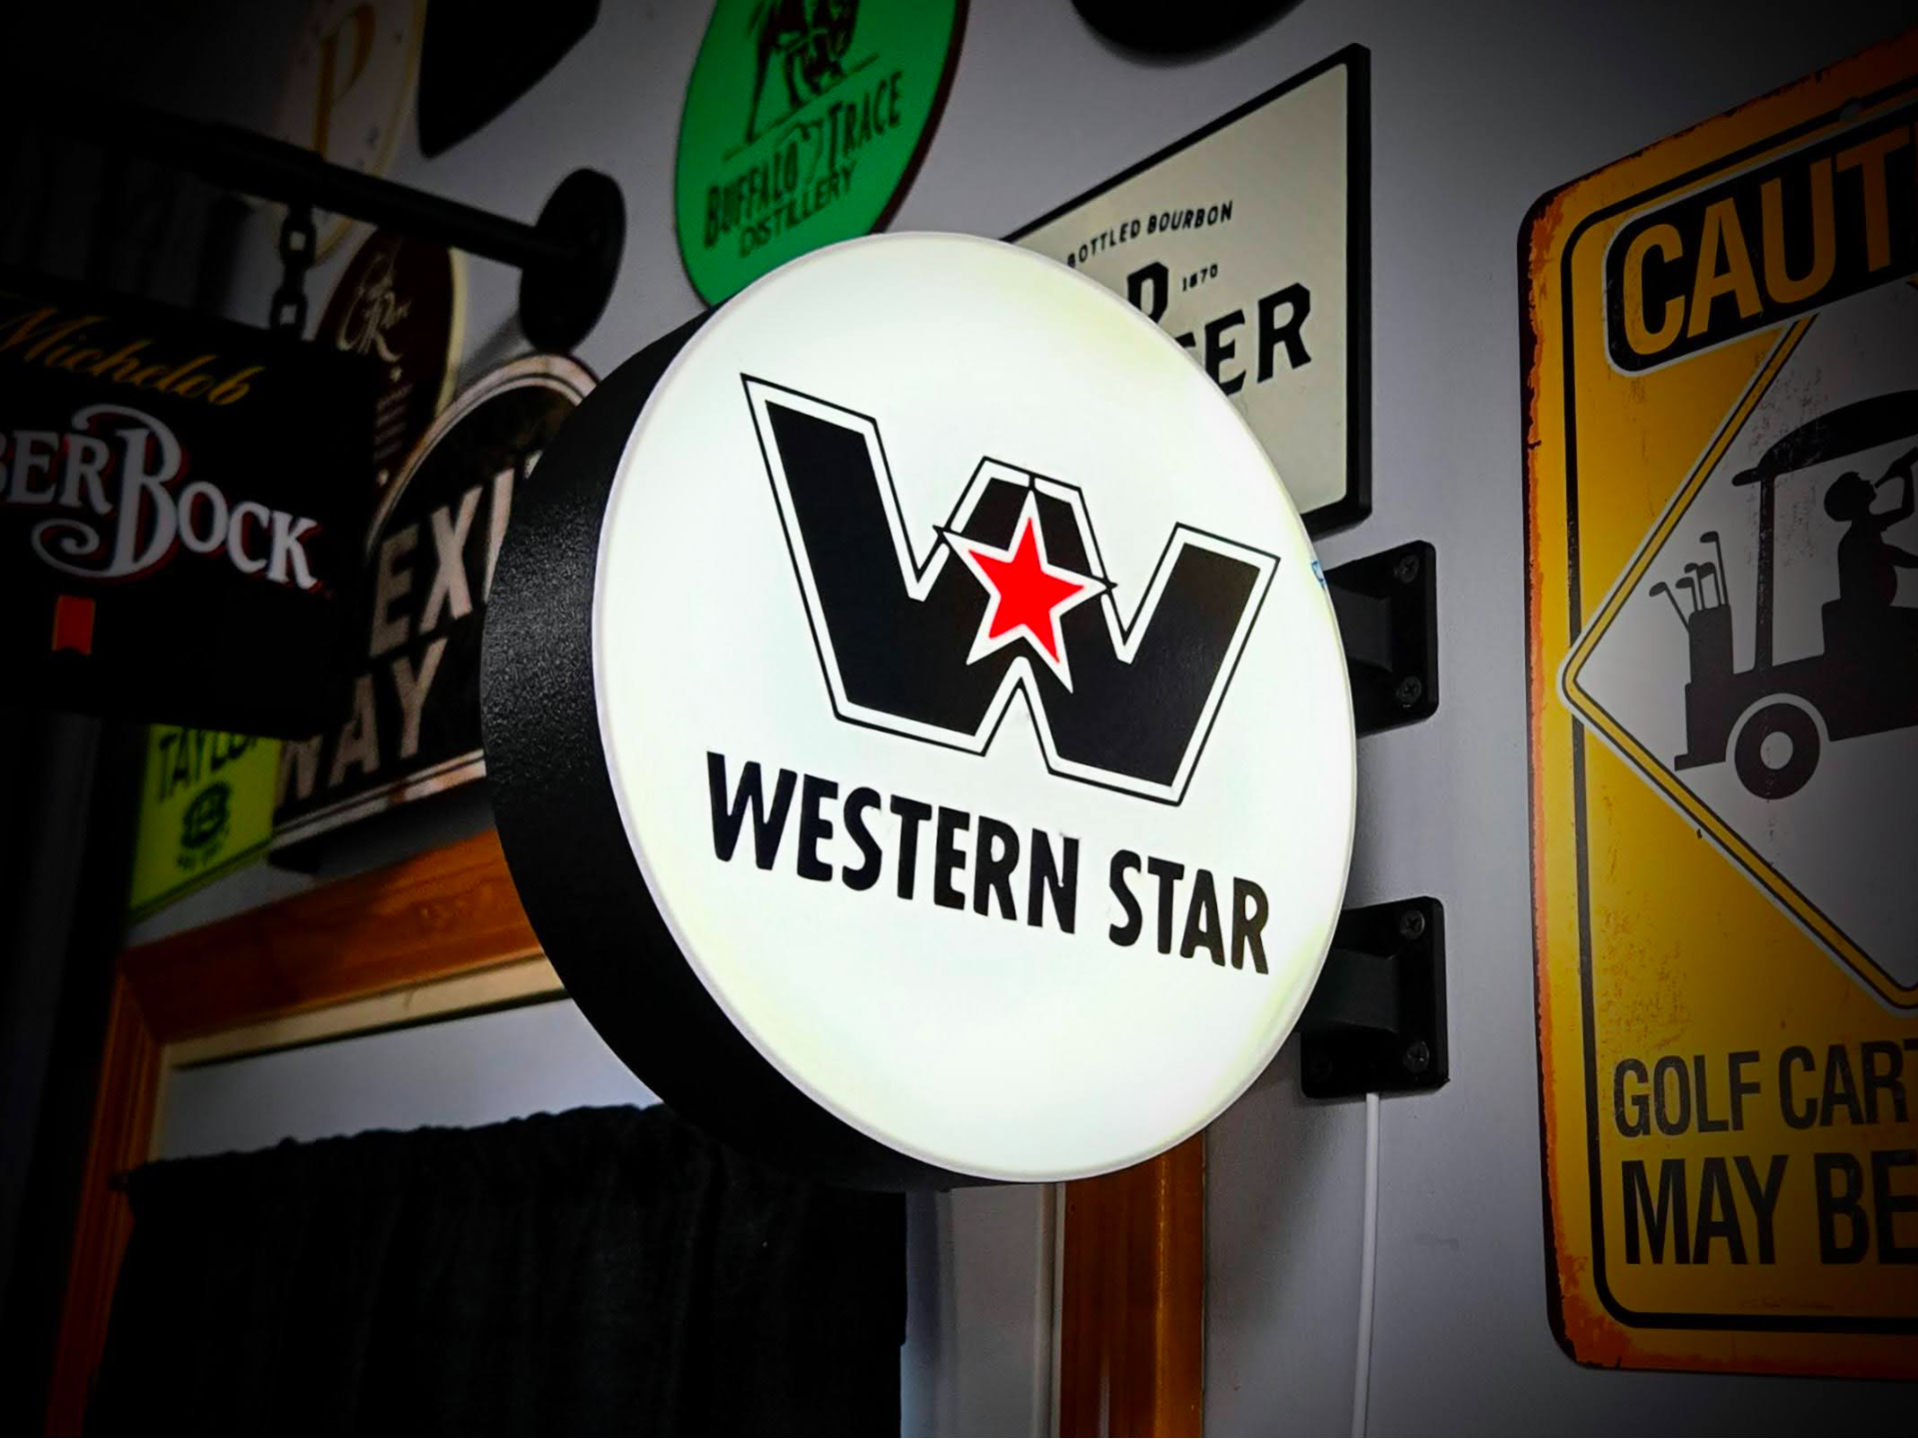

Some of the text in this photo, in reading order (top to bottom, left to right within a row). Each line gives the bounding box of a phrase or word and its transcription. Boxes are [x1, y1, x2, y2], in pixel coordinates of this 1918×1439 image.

[704, 69, 903, 249] BUFFALO TRACE
[740, 158, 857, 257] DISTILLERY
[1147, 200, 1233, 234] BOURBON
[1622, 118, 1918, 357] CAUT
[0, 302, 267, 406] Michelob
[1176, 282, 1311, 396] ER
[369, 449, 545, 659] EXI
[707, 751, 1269, 975] WESTERN STAR
[1613, 1051, 1761, 1138] GOLF
[1621, 1149, 1918, 1266] MAY BE
